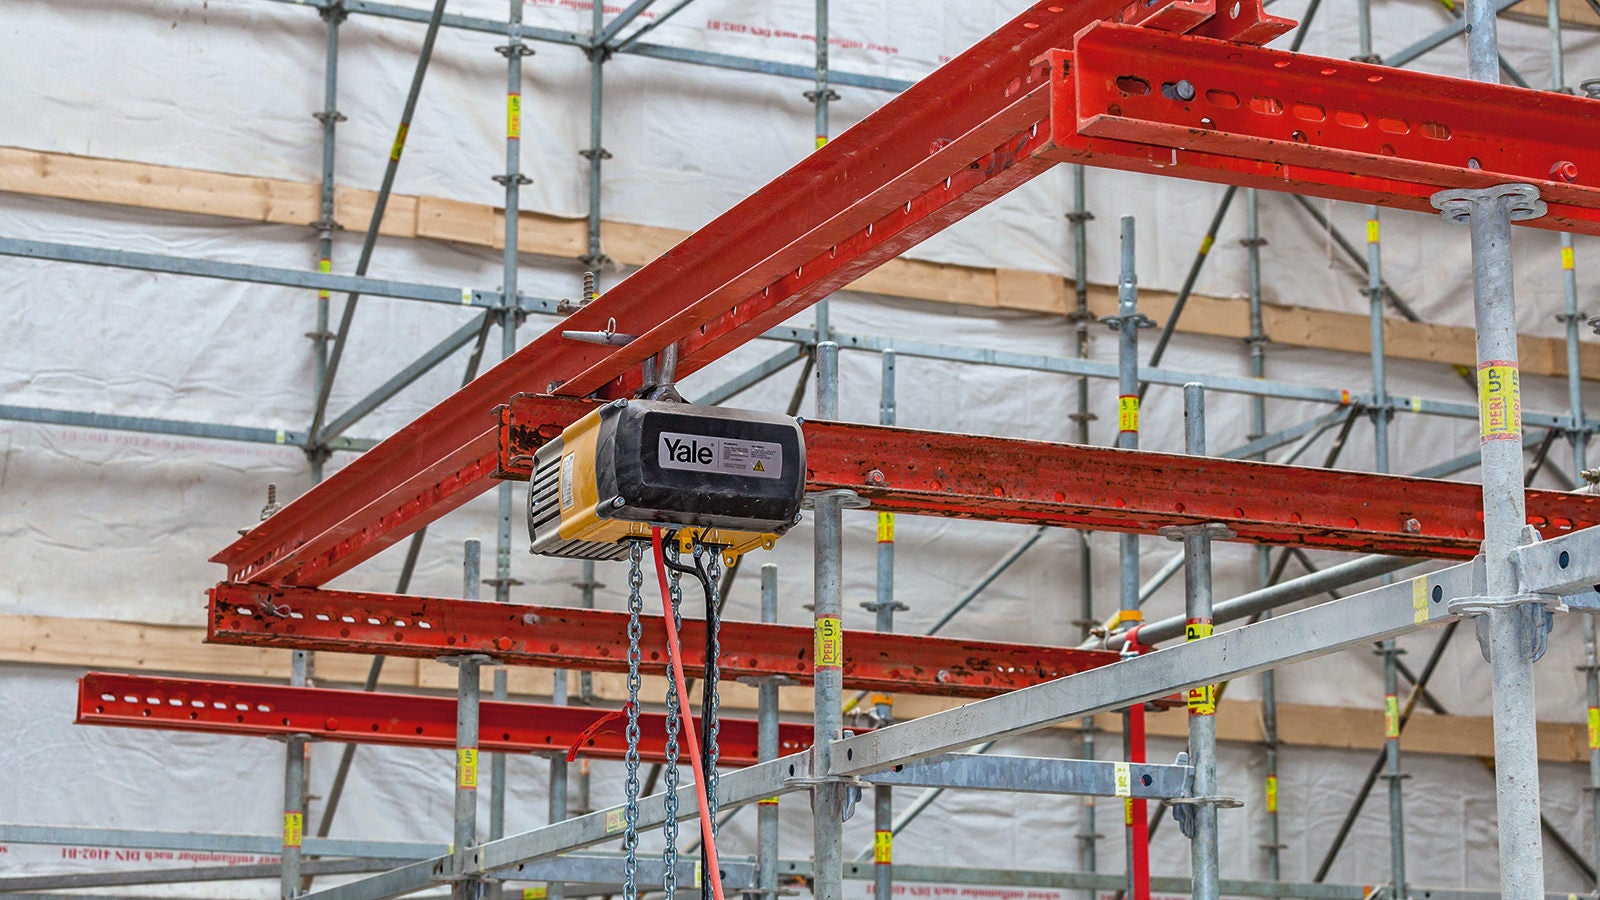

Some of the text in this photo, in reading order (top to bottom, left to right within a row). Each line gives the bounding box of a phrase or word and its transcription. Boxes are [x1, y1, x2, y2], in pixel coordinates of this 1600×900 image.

[801, 34, 863, 49] entflambar
[1488, 368, 1503, 427] PERI UP
[663, 437, 713, 465] Yale
[823, 619, 833, 661] PERI UP
[464, 750, 472, 764] UP
[62, 848, 110, 861] 4102-B1
[116, 850, 141, 862] DIN
[145, 852, 174, 861] nach
[179, 853, 254, 866] entflammbar
